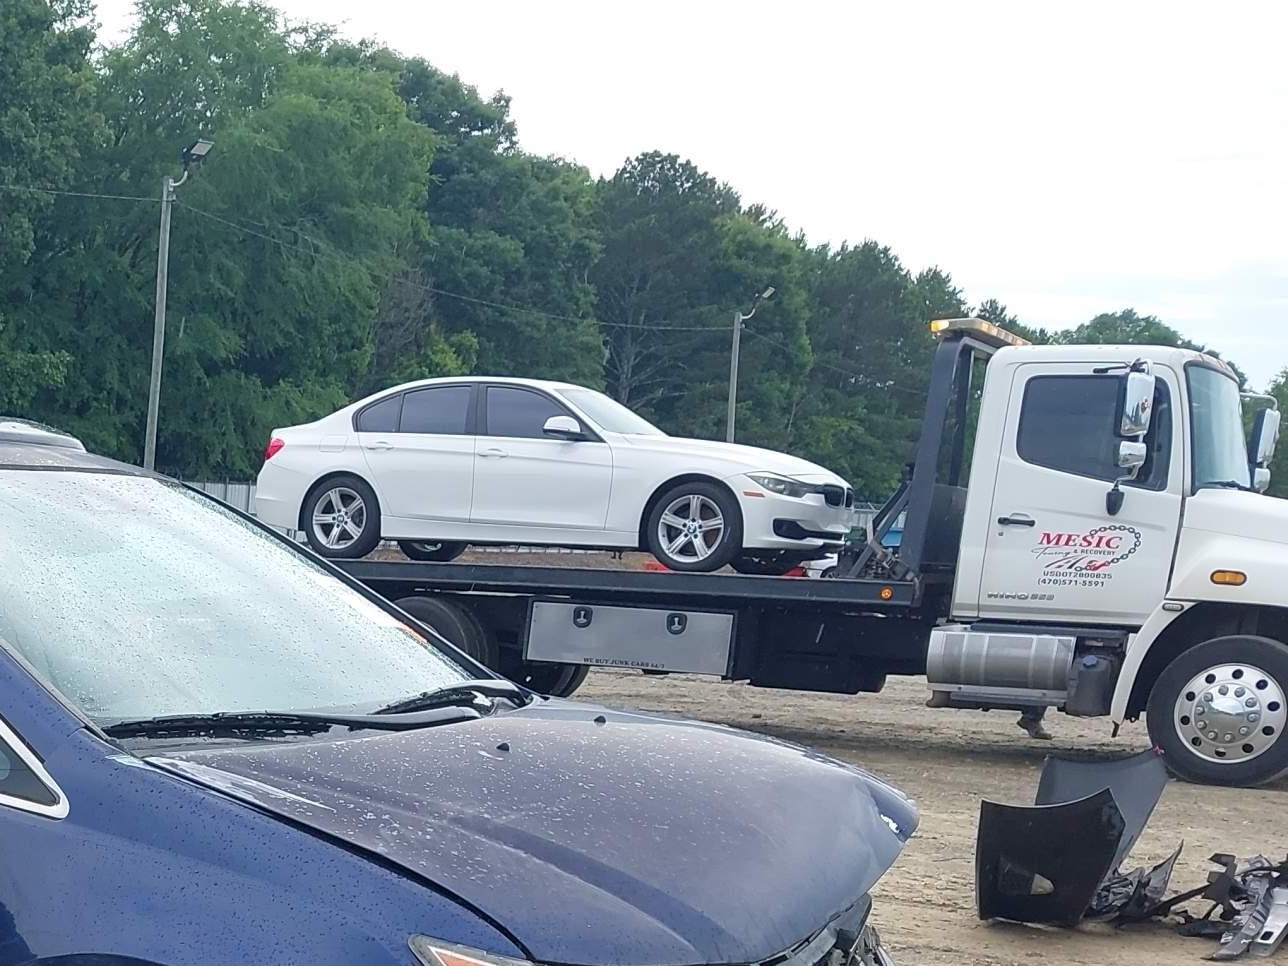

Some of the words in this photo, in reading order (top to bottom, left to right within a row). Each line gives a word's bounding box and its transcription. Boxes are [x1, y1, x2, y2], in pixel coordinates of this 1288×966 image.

[1038, 532, 1123, 549] MESIC
[1080, 548, 1116, 556] RECOVERY
[1037, 577, 1105, 588] (470)571-5591
